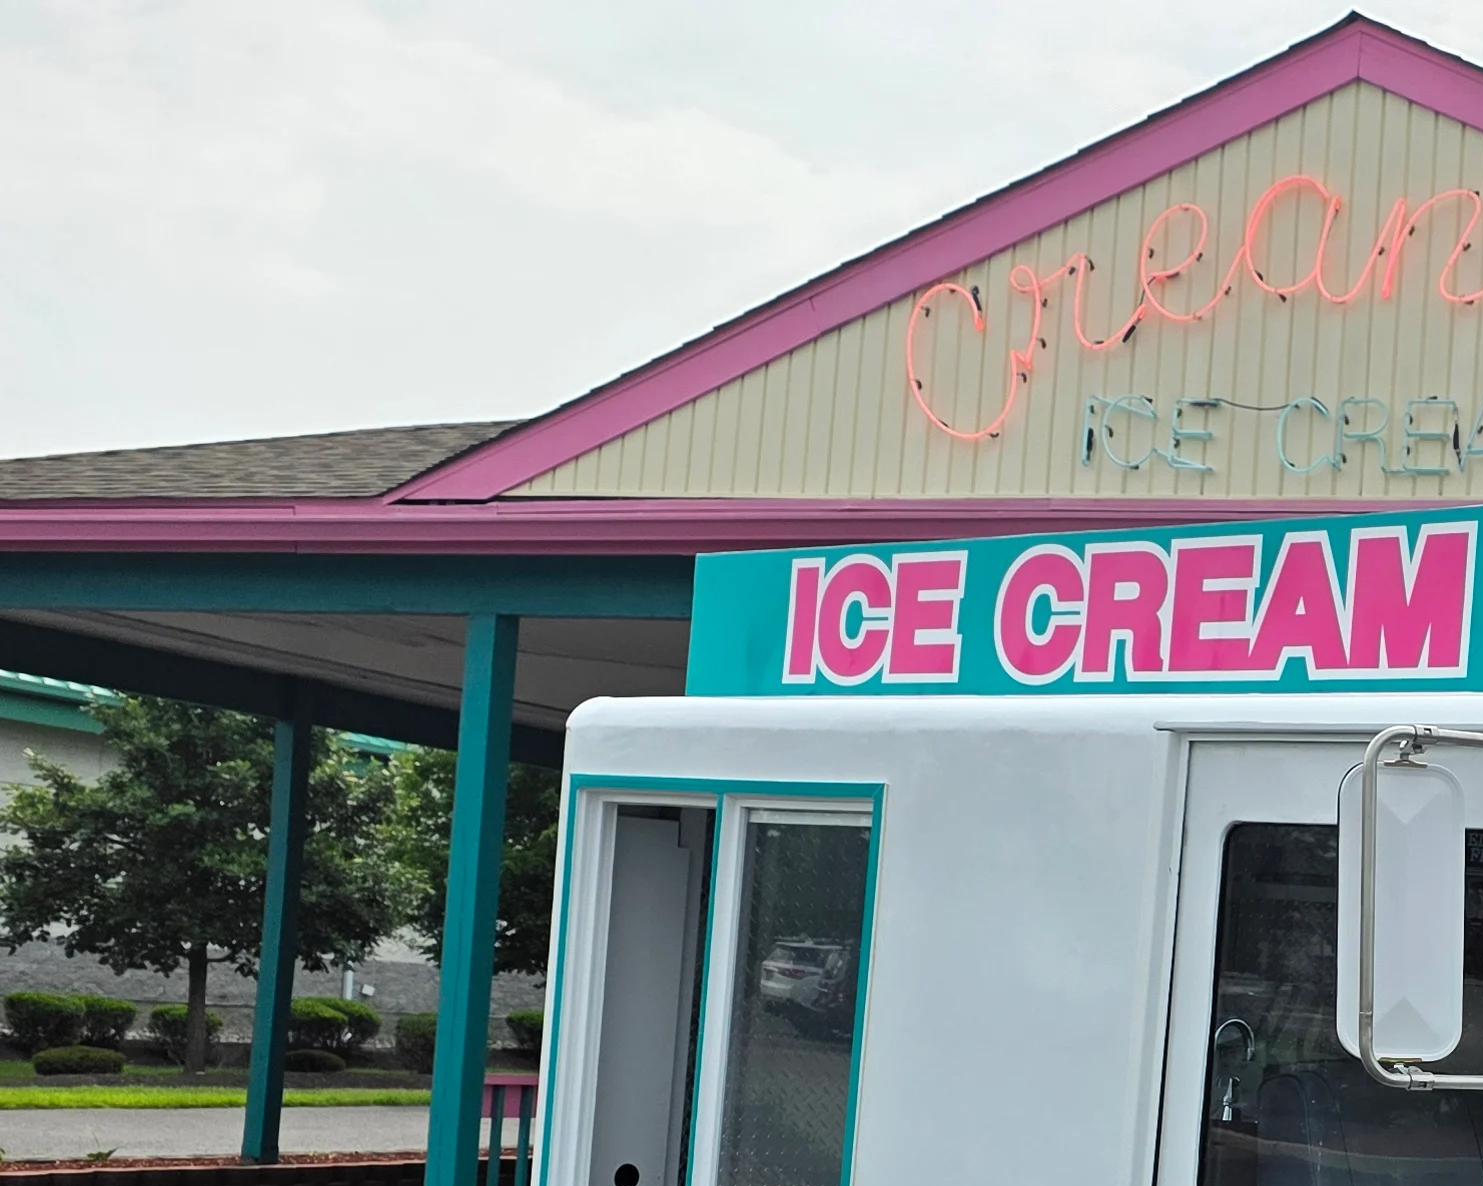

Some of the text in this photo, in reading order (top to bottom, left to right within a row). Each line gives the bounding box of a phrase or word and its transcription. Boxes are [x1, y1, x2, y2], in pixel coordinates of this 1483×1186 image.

[1081, 394, 1215, 472] ICE
[782, 520, 1479, 686] ICE CREAM
